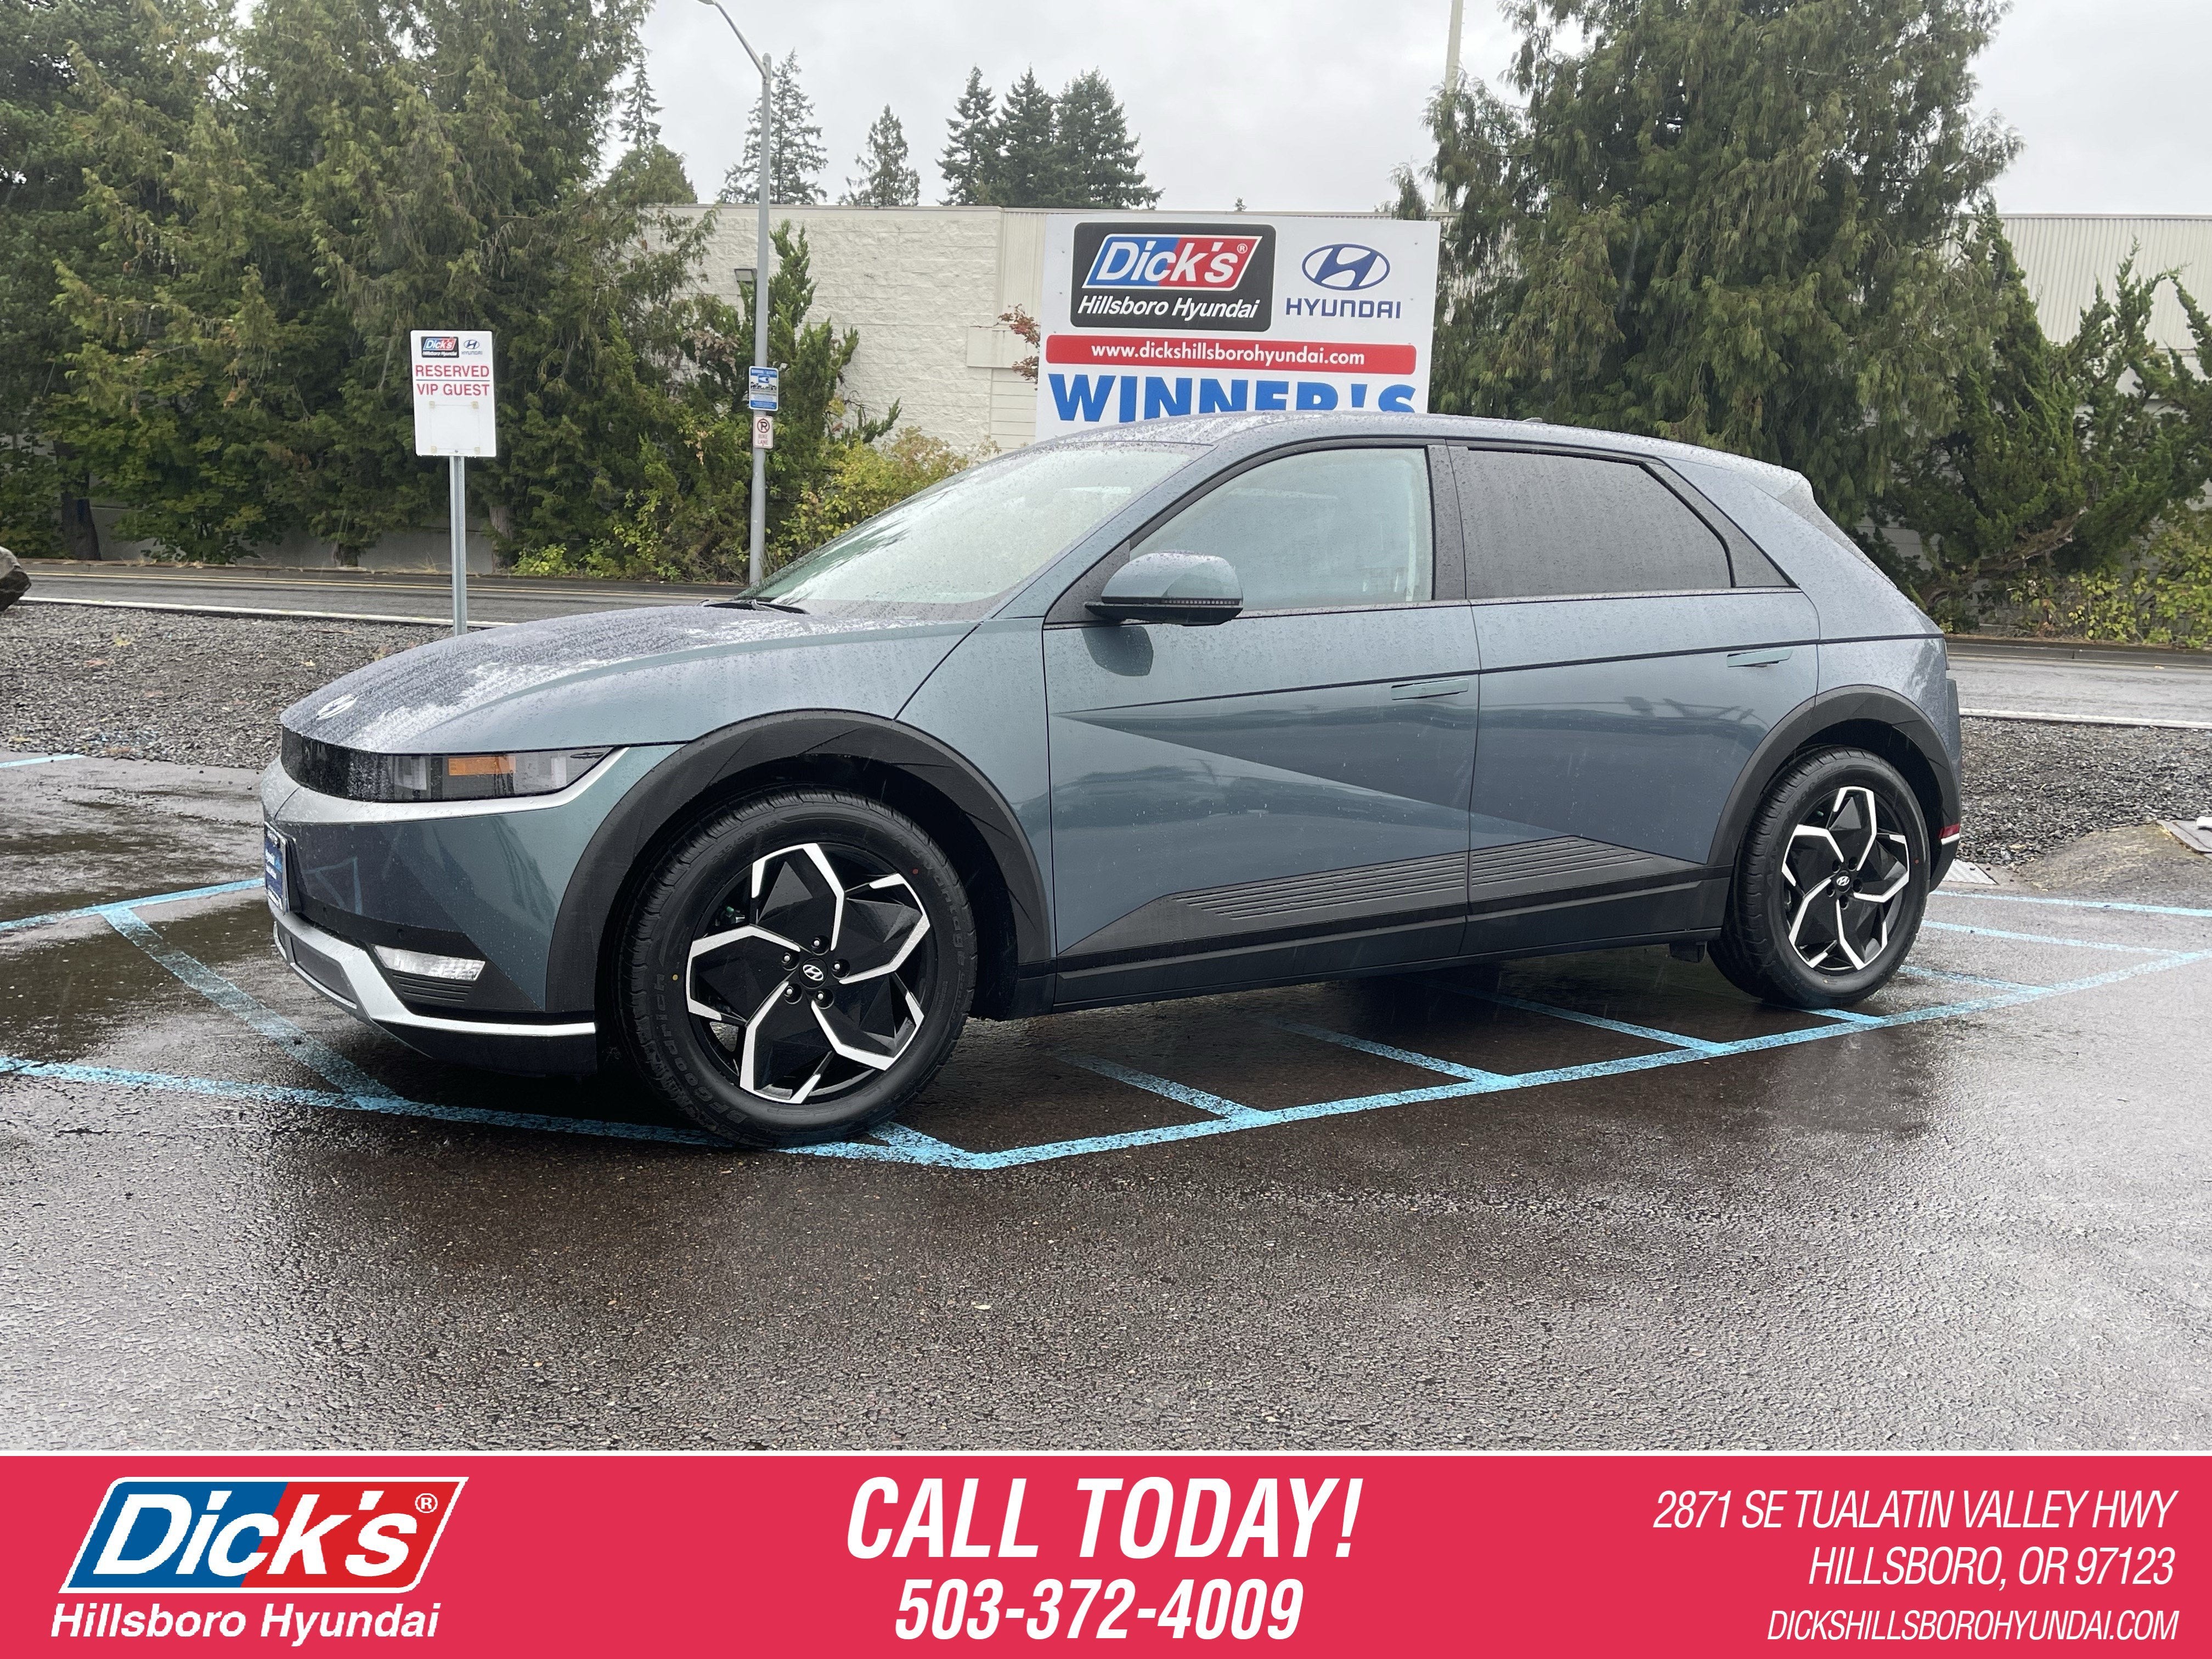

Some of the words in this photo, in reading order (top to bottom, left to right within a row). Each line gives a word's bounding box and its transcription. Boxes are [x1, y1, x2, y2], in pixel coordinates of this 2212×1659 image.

[1077, 295, 1169, 315] Hillsboro
[1171, 297, 1261, 321] Hyundai
[1286, 297, 1401, 319] HYUNDAI
[1091, 341, 1364, 366] www.dickshillsborohyundai.com
[416, 365, 489, 377] RESERVED
[416, 383, 438, 395] VIP
[443, 384, 489, 396] GUEST
[1048, 373, 1416, 422] WINNER'S
